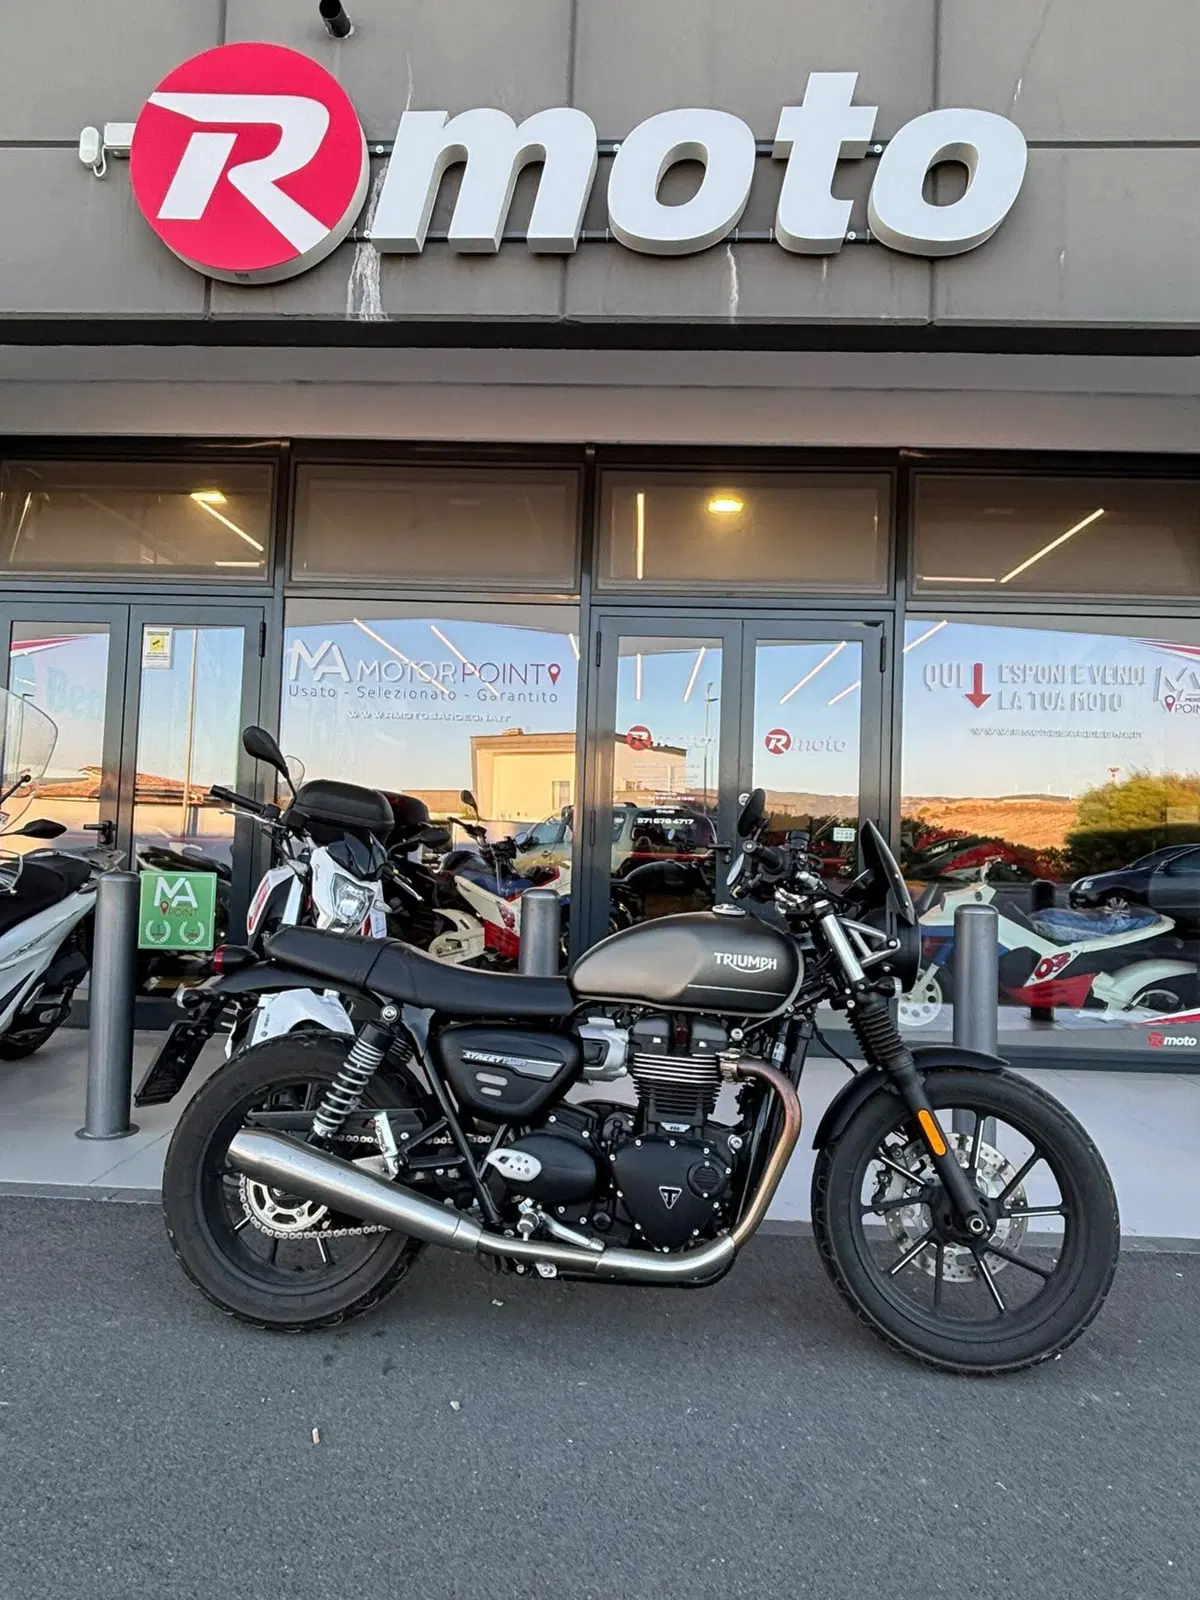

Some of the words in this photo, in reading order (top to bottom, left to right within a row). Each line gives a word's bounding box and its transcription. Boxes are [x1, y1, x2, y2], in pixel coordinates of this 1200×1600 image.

[370, 71, 1029, 256] moto
[288, 639, 353, 683] MA
[922, 662, 963, 691] QUI
[997, 663, 1067, 685] ESPONI
[288, 685, 336, 699] Usato
[356, 686, 457, 701] Selezionato
[477, 688, 558, 703] Garantito
[997, 689, 1022, 711] LA
[1027, 690, 1065, 711] TUA
[1069, 690, 1125, 712] MOTO
[153, 876, 198, 908] MA
[713, 952, 777, 974] TRIUMPH
[1163, 1035, 1197, 1047] moto
